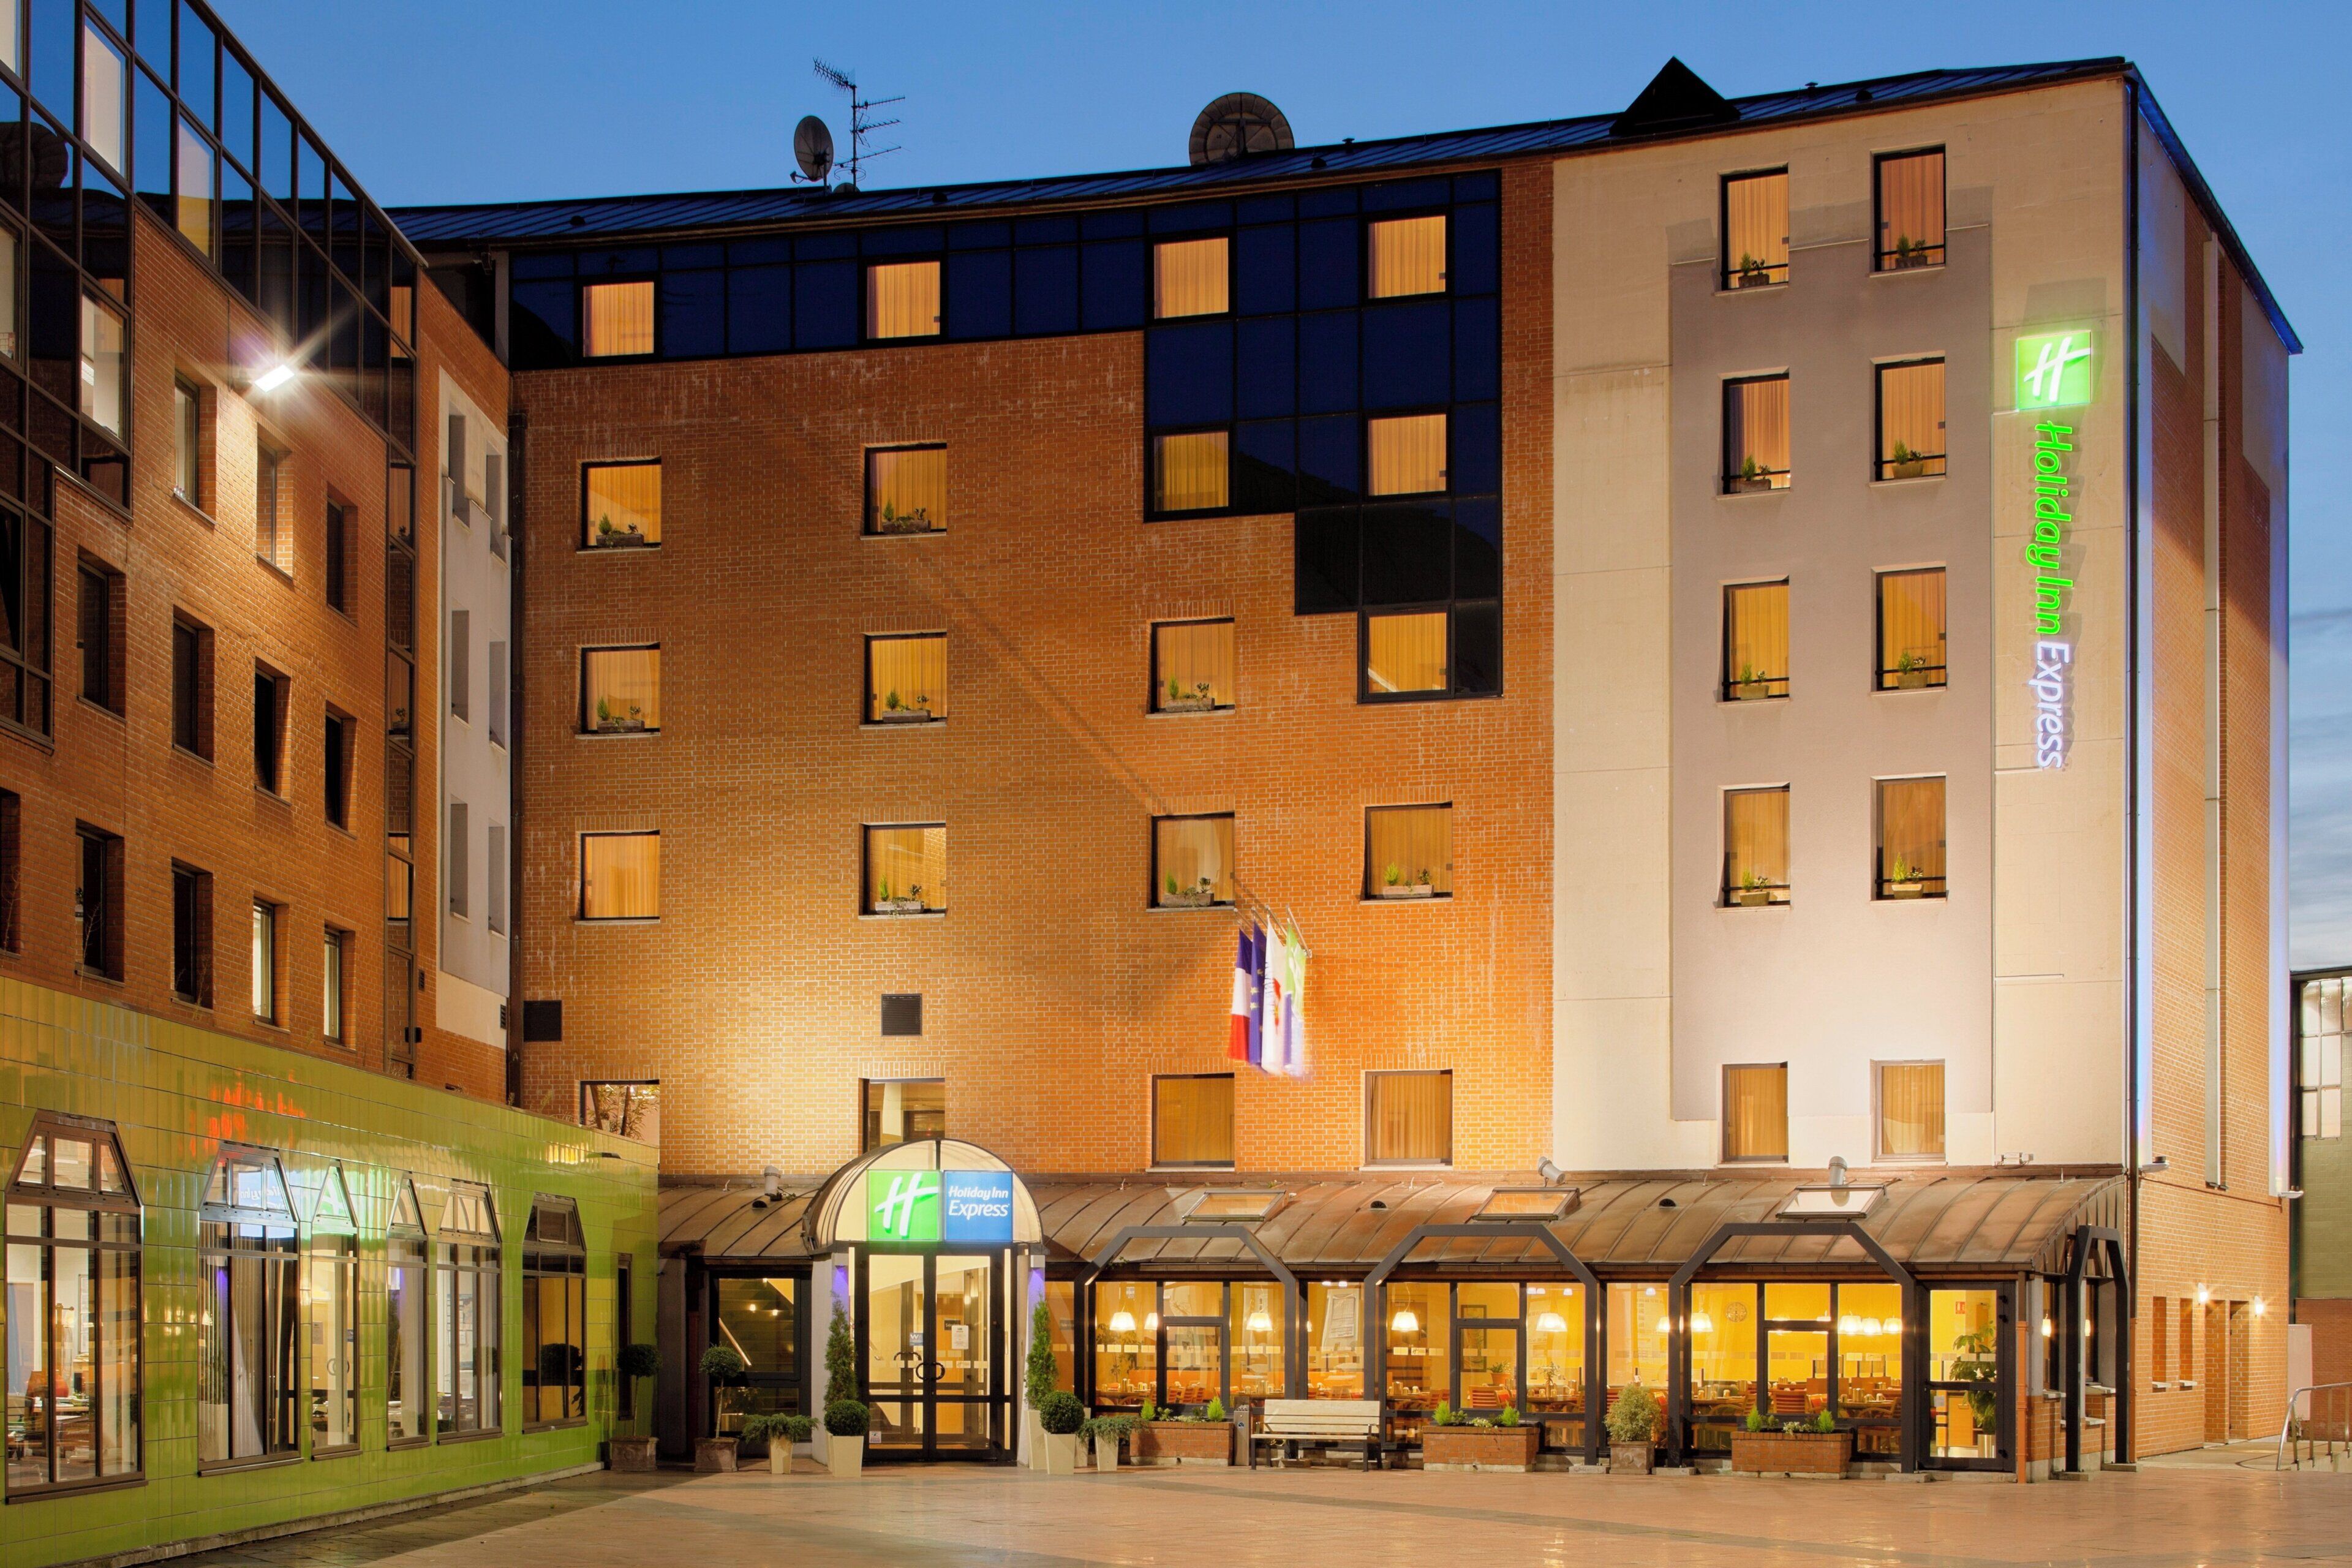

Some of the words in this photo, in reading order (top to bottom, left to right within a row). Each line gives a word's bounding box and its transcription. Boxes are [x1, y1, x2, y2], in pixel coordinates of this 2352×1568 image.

[2026, 420, 2073, 570] Holiday
[2035, 576, 2073, 635] Inn
[2028, 641, 2070, 769] Express
[948, 1185, 990, 1200] Holiday
[992, 1186, 1009, 1199] Inn
[948, 1199, 1009, 1221] Express
